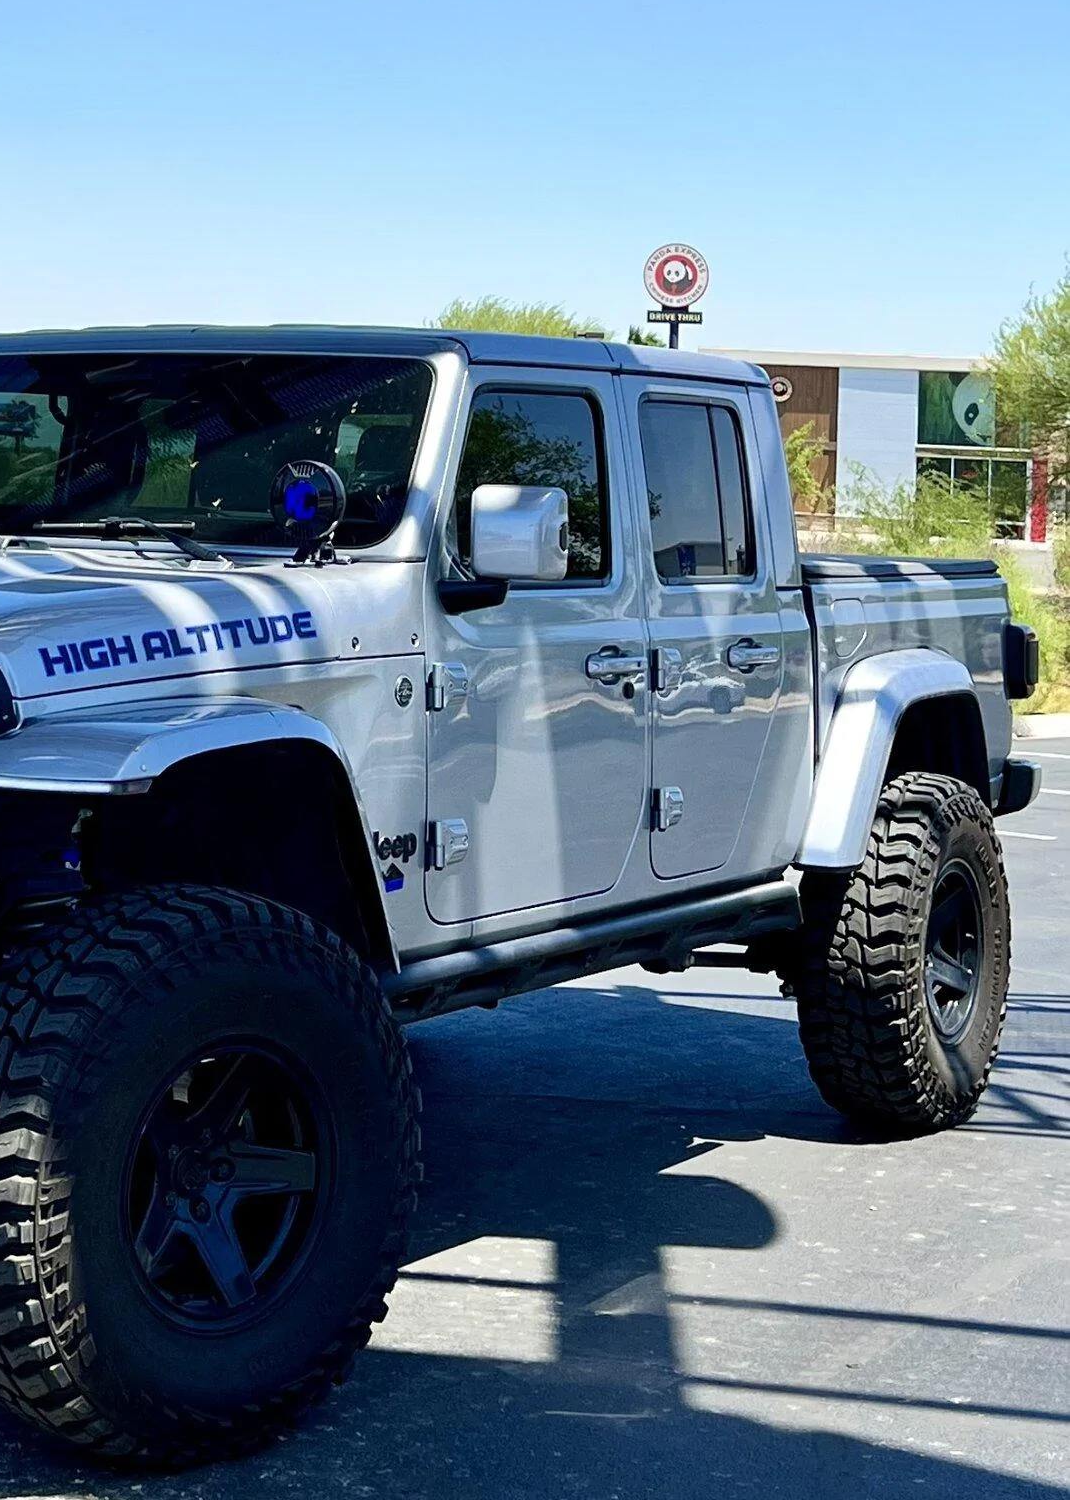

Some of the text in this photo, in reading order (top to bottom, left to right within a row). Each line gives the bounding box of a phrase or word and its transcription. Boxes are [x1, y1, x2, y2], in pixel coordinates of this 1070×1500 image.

[648, 246, 706, 274] PANDA EXPRESS
[649, 312, 701, 322] DRIVE THRU
[38, 611, 317, 677] HIGH ALTITUDE
